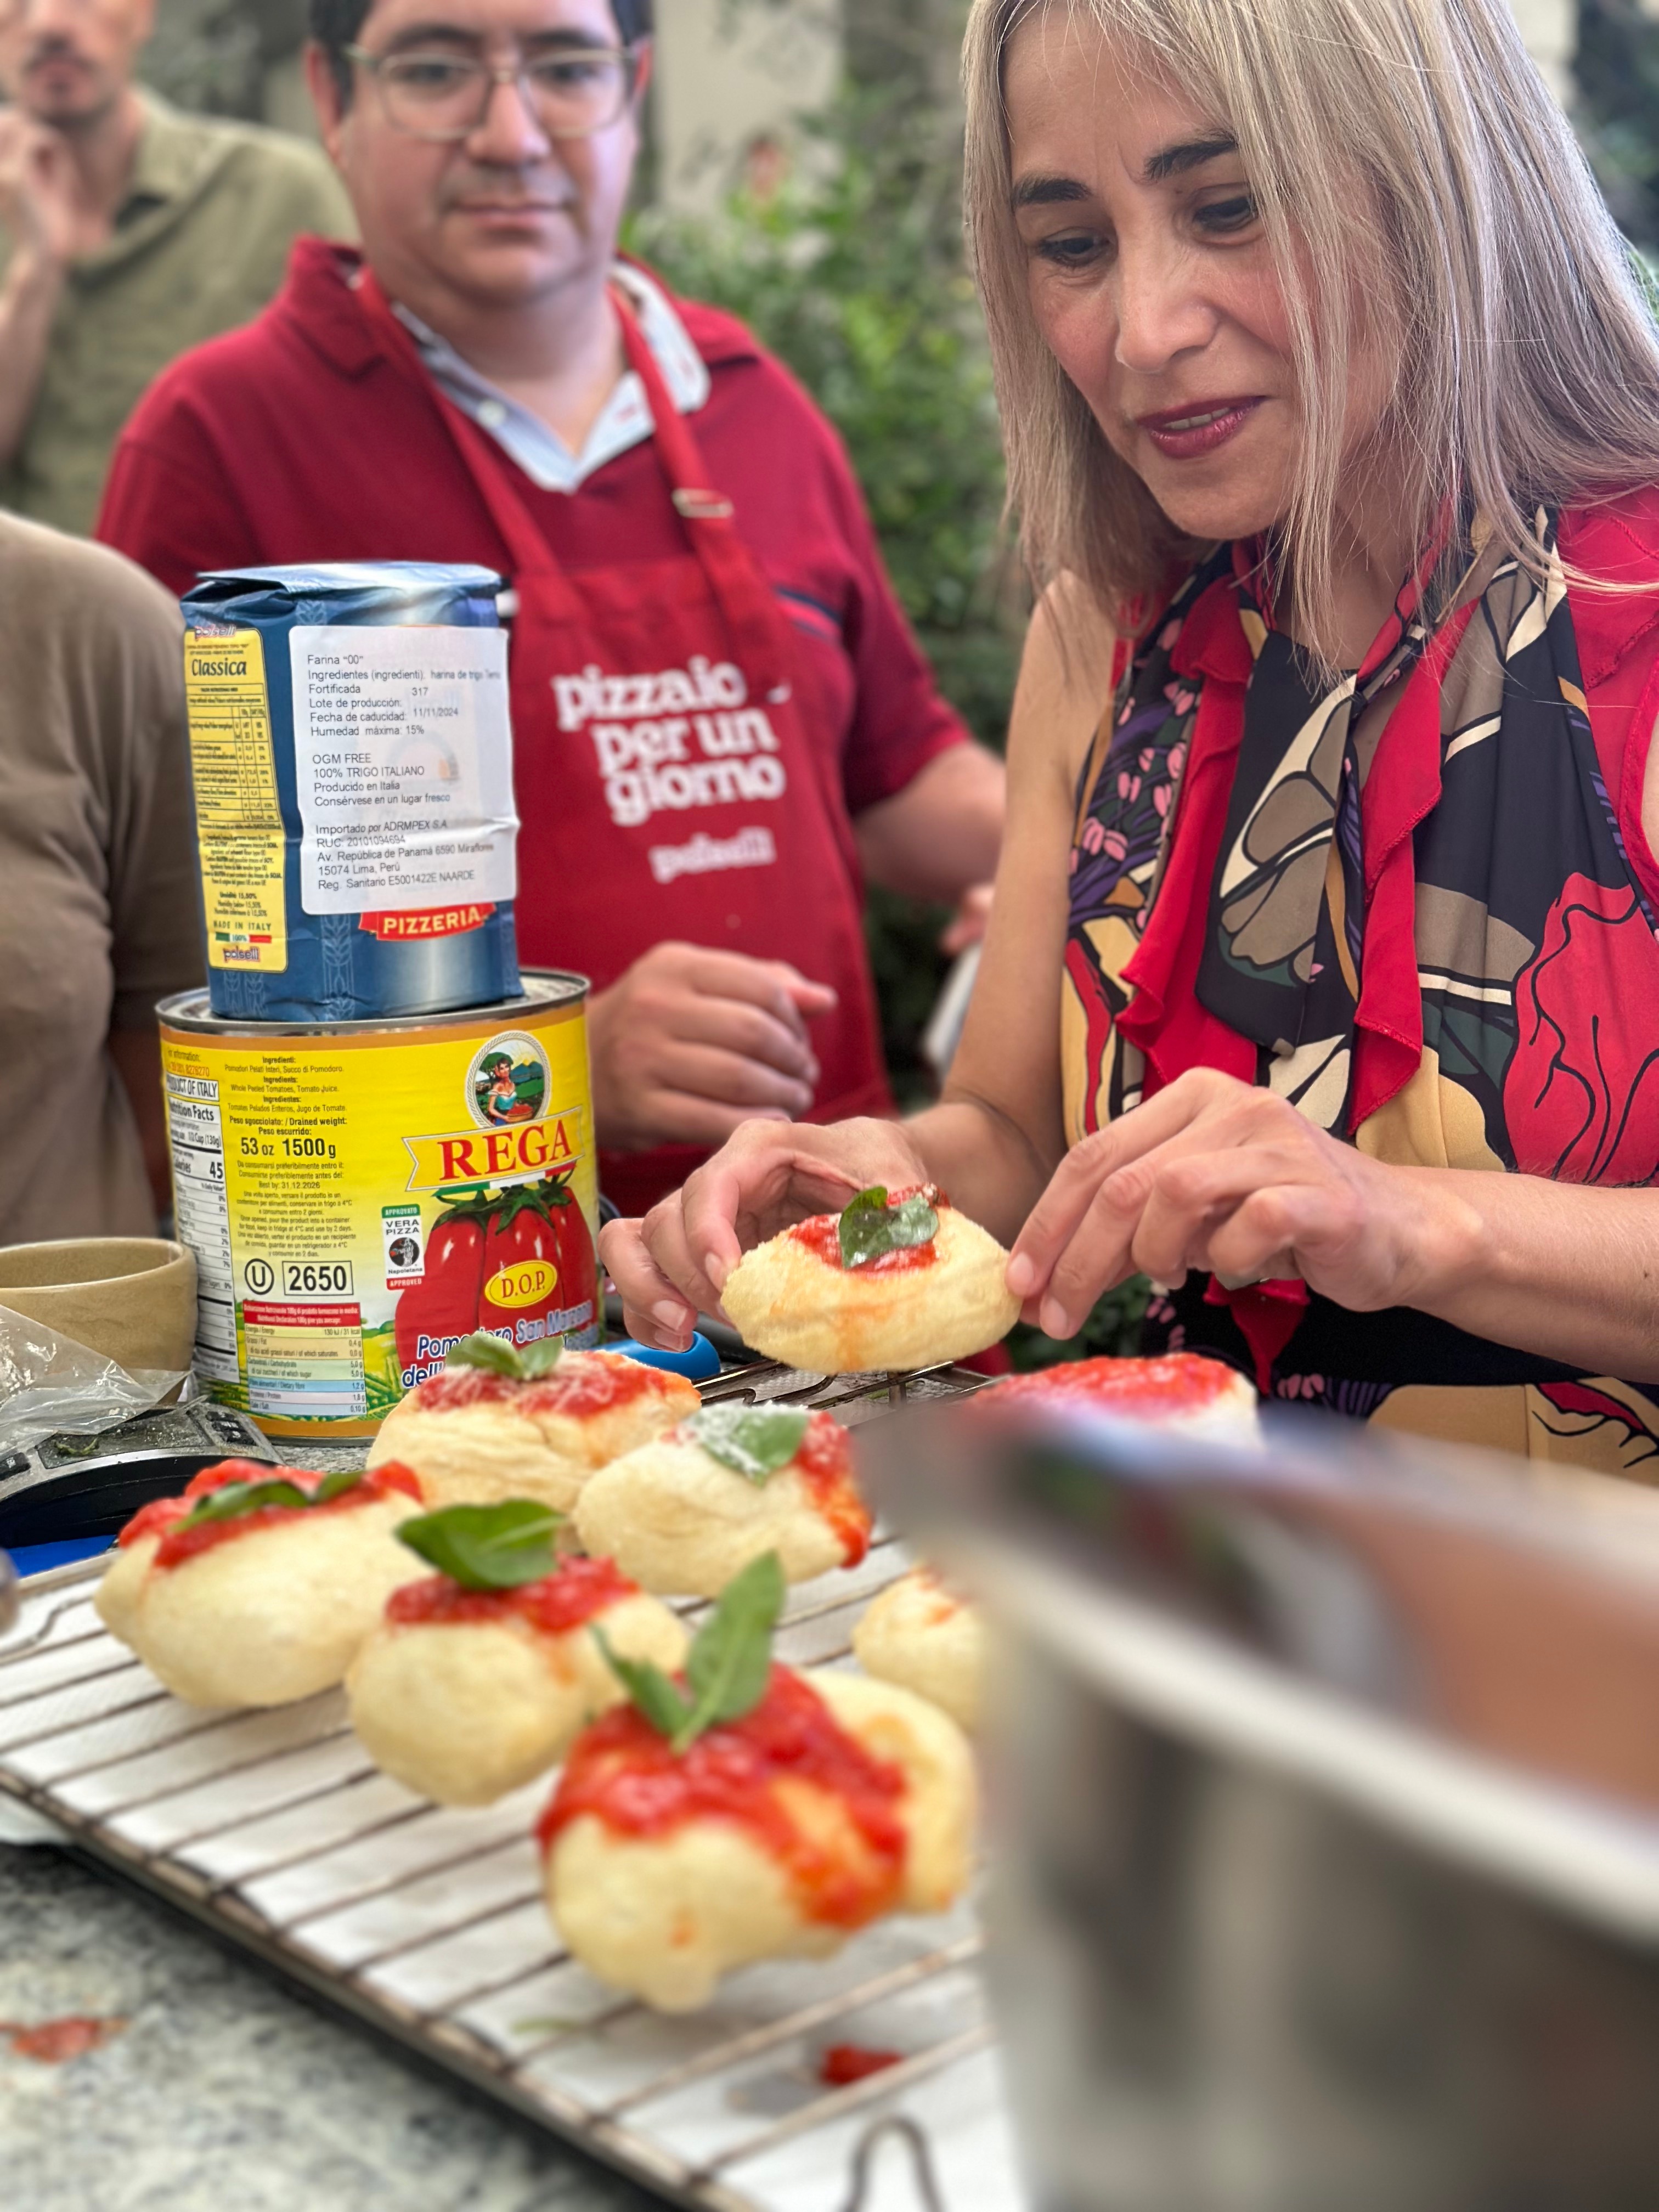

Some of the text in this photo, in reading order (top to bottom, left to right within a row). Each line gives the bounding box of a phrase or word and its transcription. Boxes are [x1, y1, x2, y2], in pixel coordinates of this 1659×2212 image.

[307, 655, 340, 665] Farina
[192, 658, 247, 676] Classica
[308, 669, 368, 681] Ingredientes
[431, 670, 455, 680] harina
[458, 670, 466, 679] de
[309, 684, 428, 696] Fortificada 317
[309, 698, 402, 710] Lote de producción:
[310, 708, 459, 722] Fecha de caducidad: 11/11/2024
[311, 725, 425, 736] Humedad máxima: 15%
[591, 708, 779, 778] per un
[313, 753, 371, 764] OGM FREE
[314, 766, 425, 778] 100% TRIGO ITALIANO
[314, 782, 364, 792] Producido
[380, 781, 400, 790] Italia
[606, 754, 785, 826] giorno
[314, 795, 372, 806] Consérvese
[401, 794, 421, 805] lugar
[425, 794, 450, 803] fresco
[316, 823, 366, 837] Importado
[368, 824, 381, 833] por
[383, 821, 430, 831] ADRMPEX
[317, 834, 405, 848] RUC: 20101094694
[318, 851, 334, 862] Av.
[338, 850, 381, 862] República
[385, 849, 395, 858] de
[398, 846, 433, 857] Panamá
[436, 844, 455, 855] 6590
[319, 862, 400, 876] 15074 Lima, Perú
[318, 870, 475, 891] Reg. Sanitario E5001422E NAARDE
[213, 921, 230, 929] MADE
[249, 923, 272, 931] ITALY
[383, 906, 481, 934] PIZZERIA
[263, 1056, 296, 1065] Ingredienti:
[263, 1076, 298, 1085] Ingredients:
[188, 1080, 195, 1095] OF
[197, 1079, 217, 1098] ITALY
[266, 1085, 296, 1093] Tomatoes,
[263, 1096, 302, 1104] Ingredientes:
[193, 1105, 214, 1121] Facts
[228, 1103, 248, 1111] Tomates
[250, 1103, 270, 1112] Pelados
[272, 1104, 295, 1113] Enteros,
[297, 1104, 312, 1114] Jugo
[229, 1116, 244, 1125] Peso
[245, 1116, 284, 1126] sgocciolato:
[289, 1118, 318, 1126] Drained
[319, 1117, 347, 1126] weight:
[259, 1127, 312, 1136] Peso escurrido:
[241, 1137, 336, 1159] 53 oz 1500 g
[437, 1120, 572, 1181] REGA
[210, 1161, 224, 1180] 45
[245, 1161, 274, 1169] consumarsi
[276, 1161, 319, 1170] preferibilmente
[239, 1170, 268, 1178] Consumirse
[269, 1171, 313, 1180] preferiblemente
[324, 1200, 336, 1208] frigo
[385, 1207, 417, 1216] APPROVATO
[274, 1224, 288, 1233] fridge
[386, 1219, 419, 1228] VERA
[288, 1265, 347, 1291] 2650
[390, 1278, 422, 1287] APPROVED
[417, 1327, 513, 1359] Pomro
[516, 1319, 545, 1344] San
